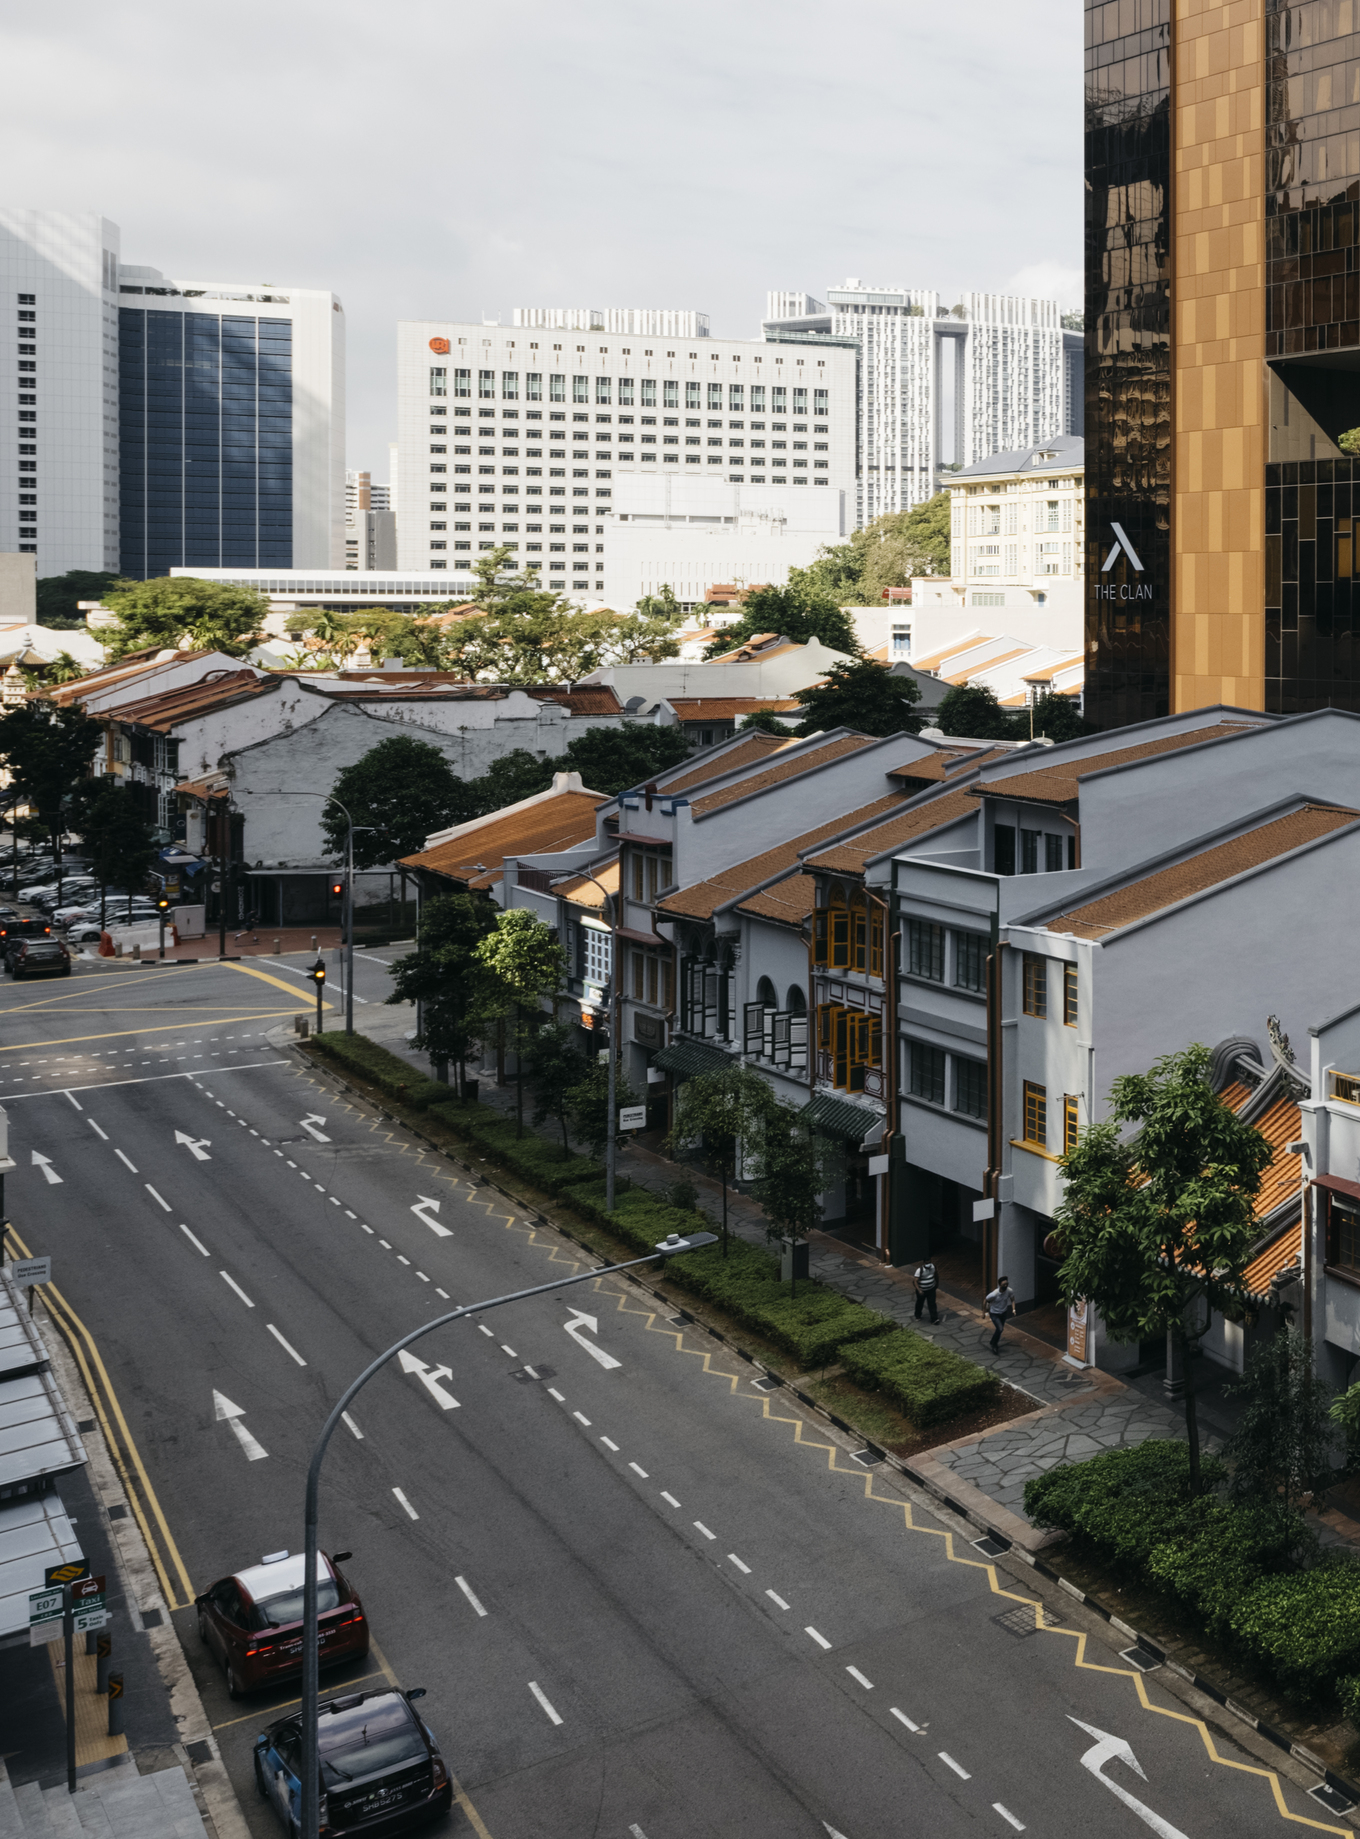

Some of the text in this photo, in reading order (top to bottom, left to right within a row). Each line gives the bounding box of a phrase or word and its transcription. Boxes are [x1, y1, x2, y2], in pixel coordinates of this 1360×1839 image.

[1094, 584, 1152, 600] THE CLAN
[17, 1264, 46, 1273] PEDESTRIANS
[36, 1598, 57, 1611] E07
[79, 1594, 100, 1606] Taxi
[78, 1618, 88, 1629] 5
[362, 1792, 403, 1812] SHB527S
